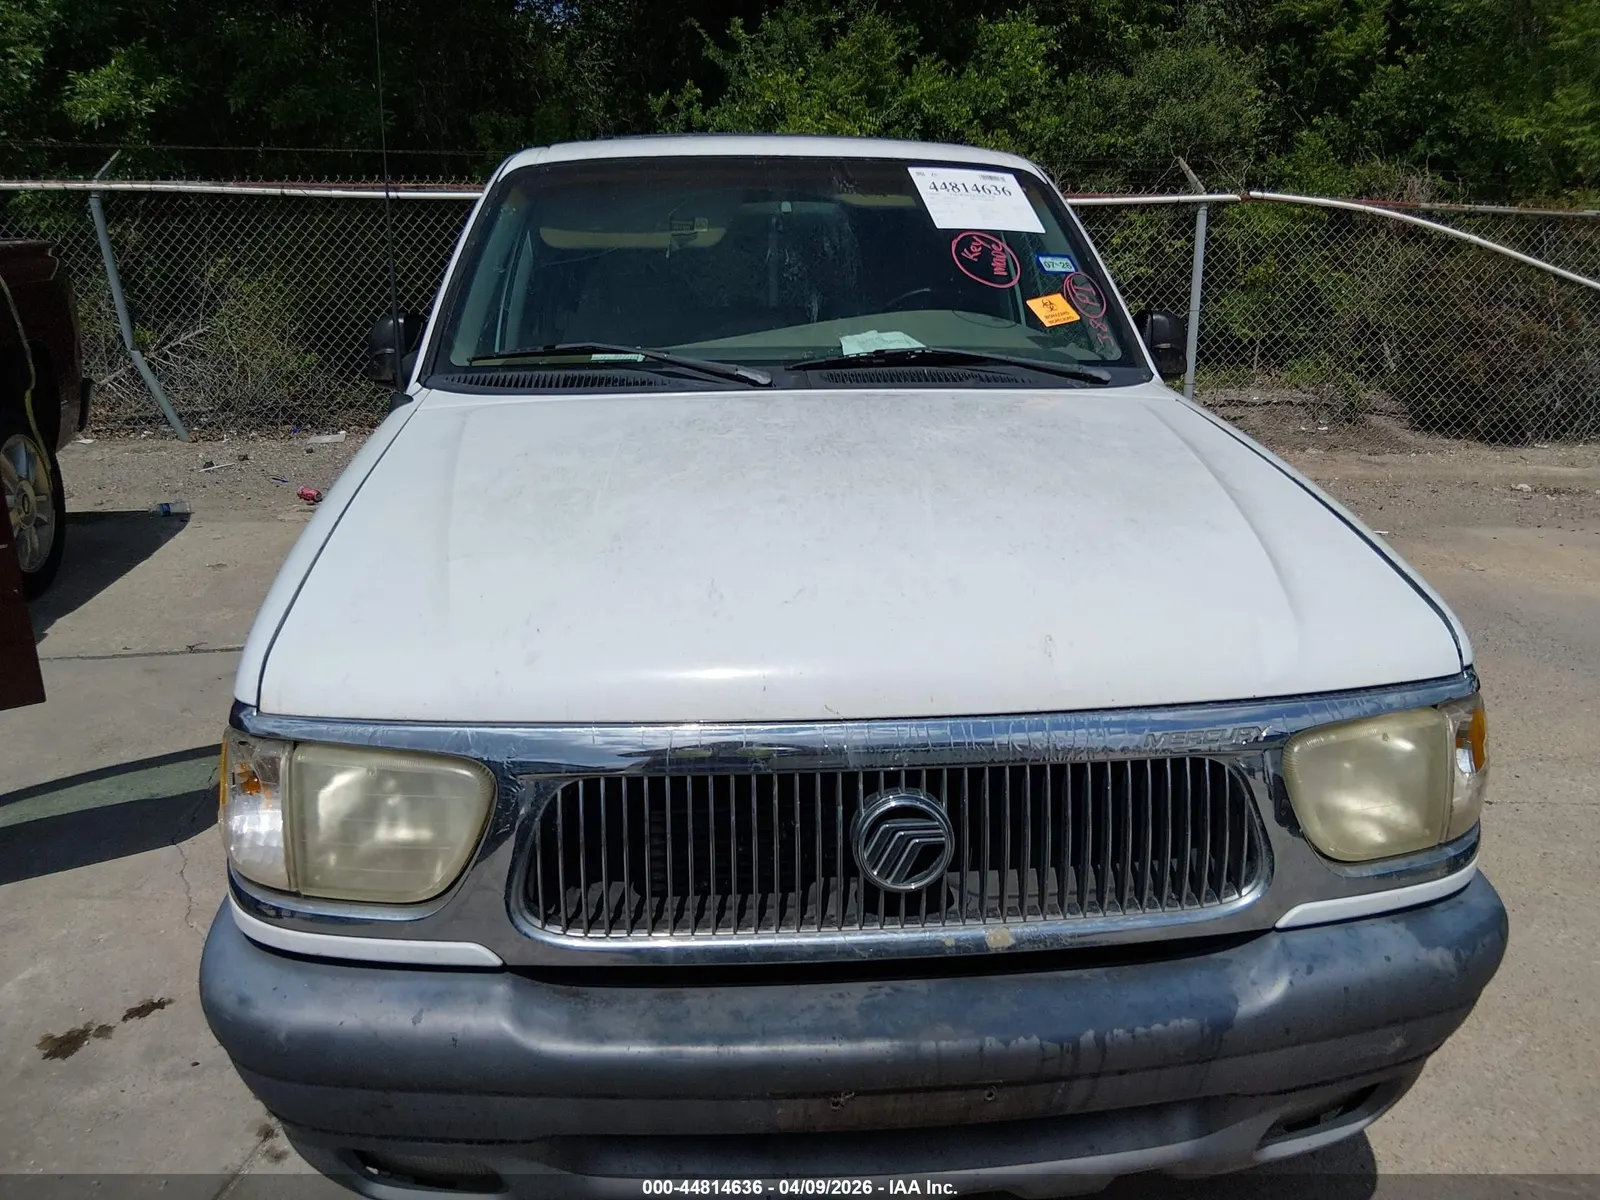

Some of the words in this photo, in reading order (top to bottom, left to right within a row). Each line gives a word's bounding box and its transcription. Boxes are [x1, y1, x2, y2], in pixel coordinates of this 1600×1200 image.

[929, 181, 1012, 197] 44814636
[961, 235, 991, 261] Key
[1144, 725, 1272, 749] MERCURY
